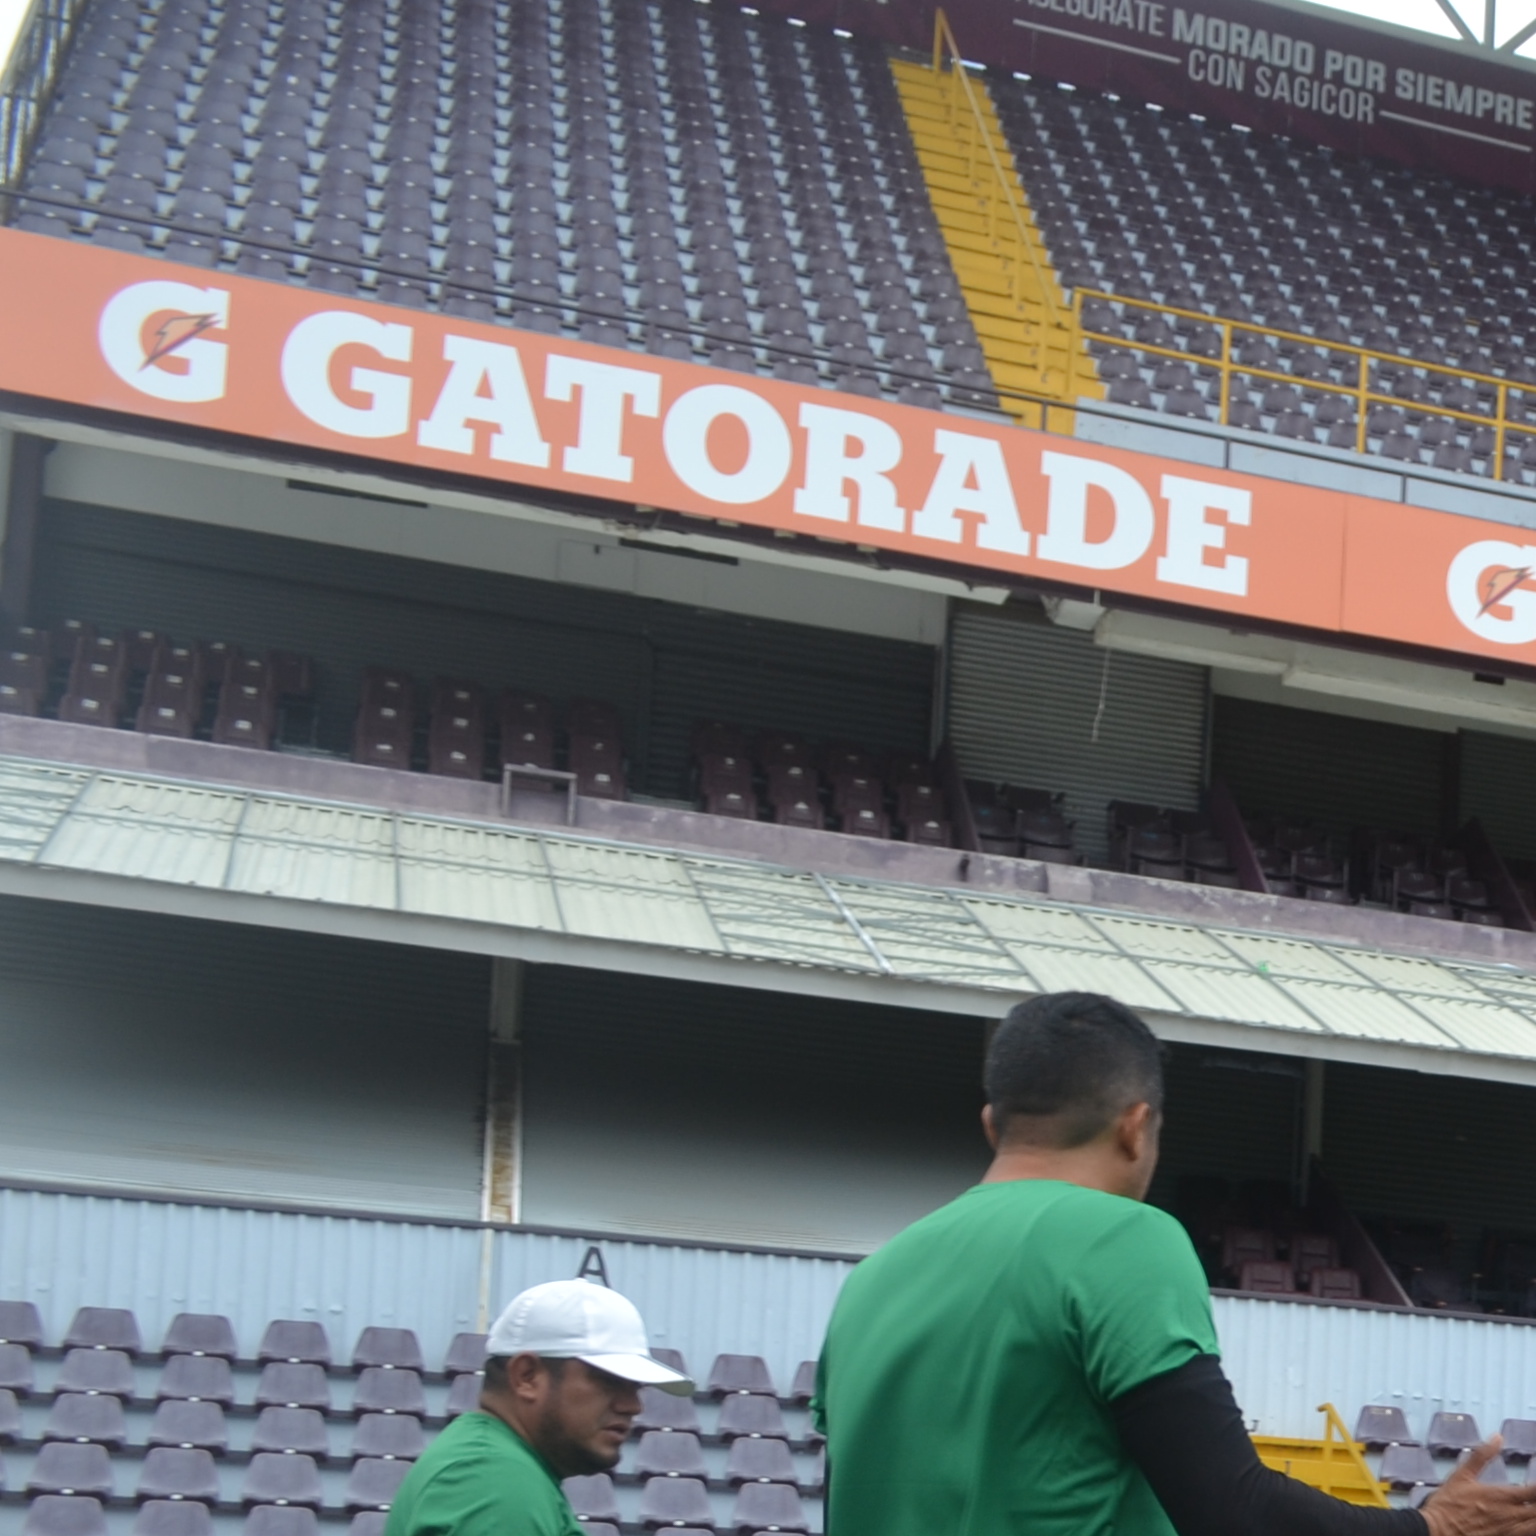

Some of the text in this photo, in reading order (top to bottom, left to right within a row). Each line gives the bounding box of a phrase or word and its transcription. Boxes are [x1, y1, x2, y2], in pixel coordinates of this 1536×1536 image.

[1015, 0, 1535, 130] GURATE MORADO POR SIEMPRE
[1187, 49, 1375, 125] CON SAGICOR
[280, 308, 1252, 597] GATORADE
[575, 1246, 611, 1289] A
